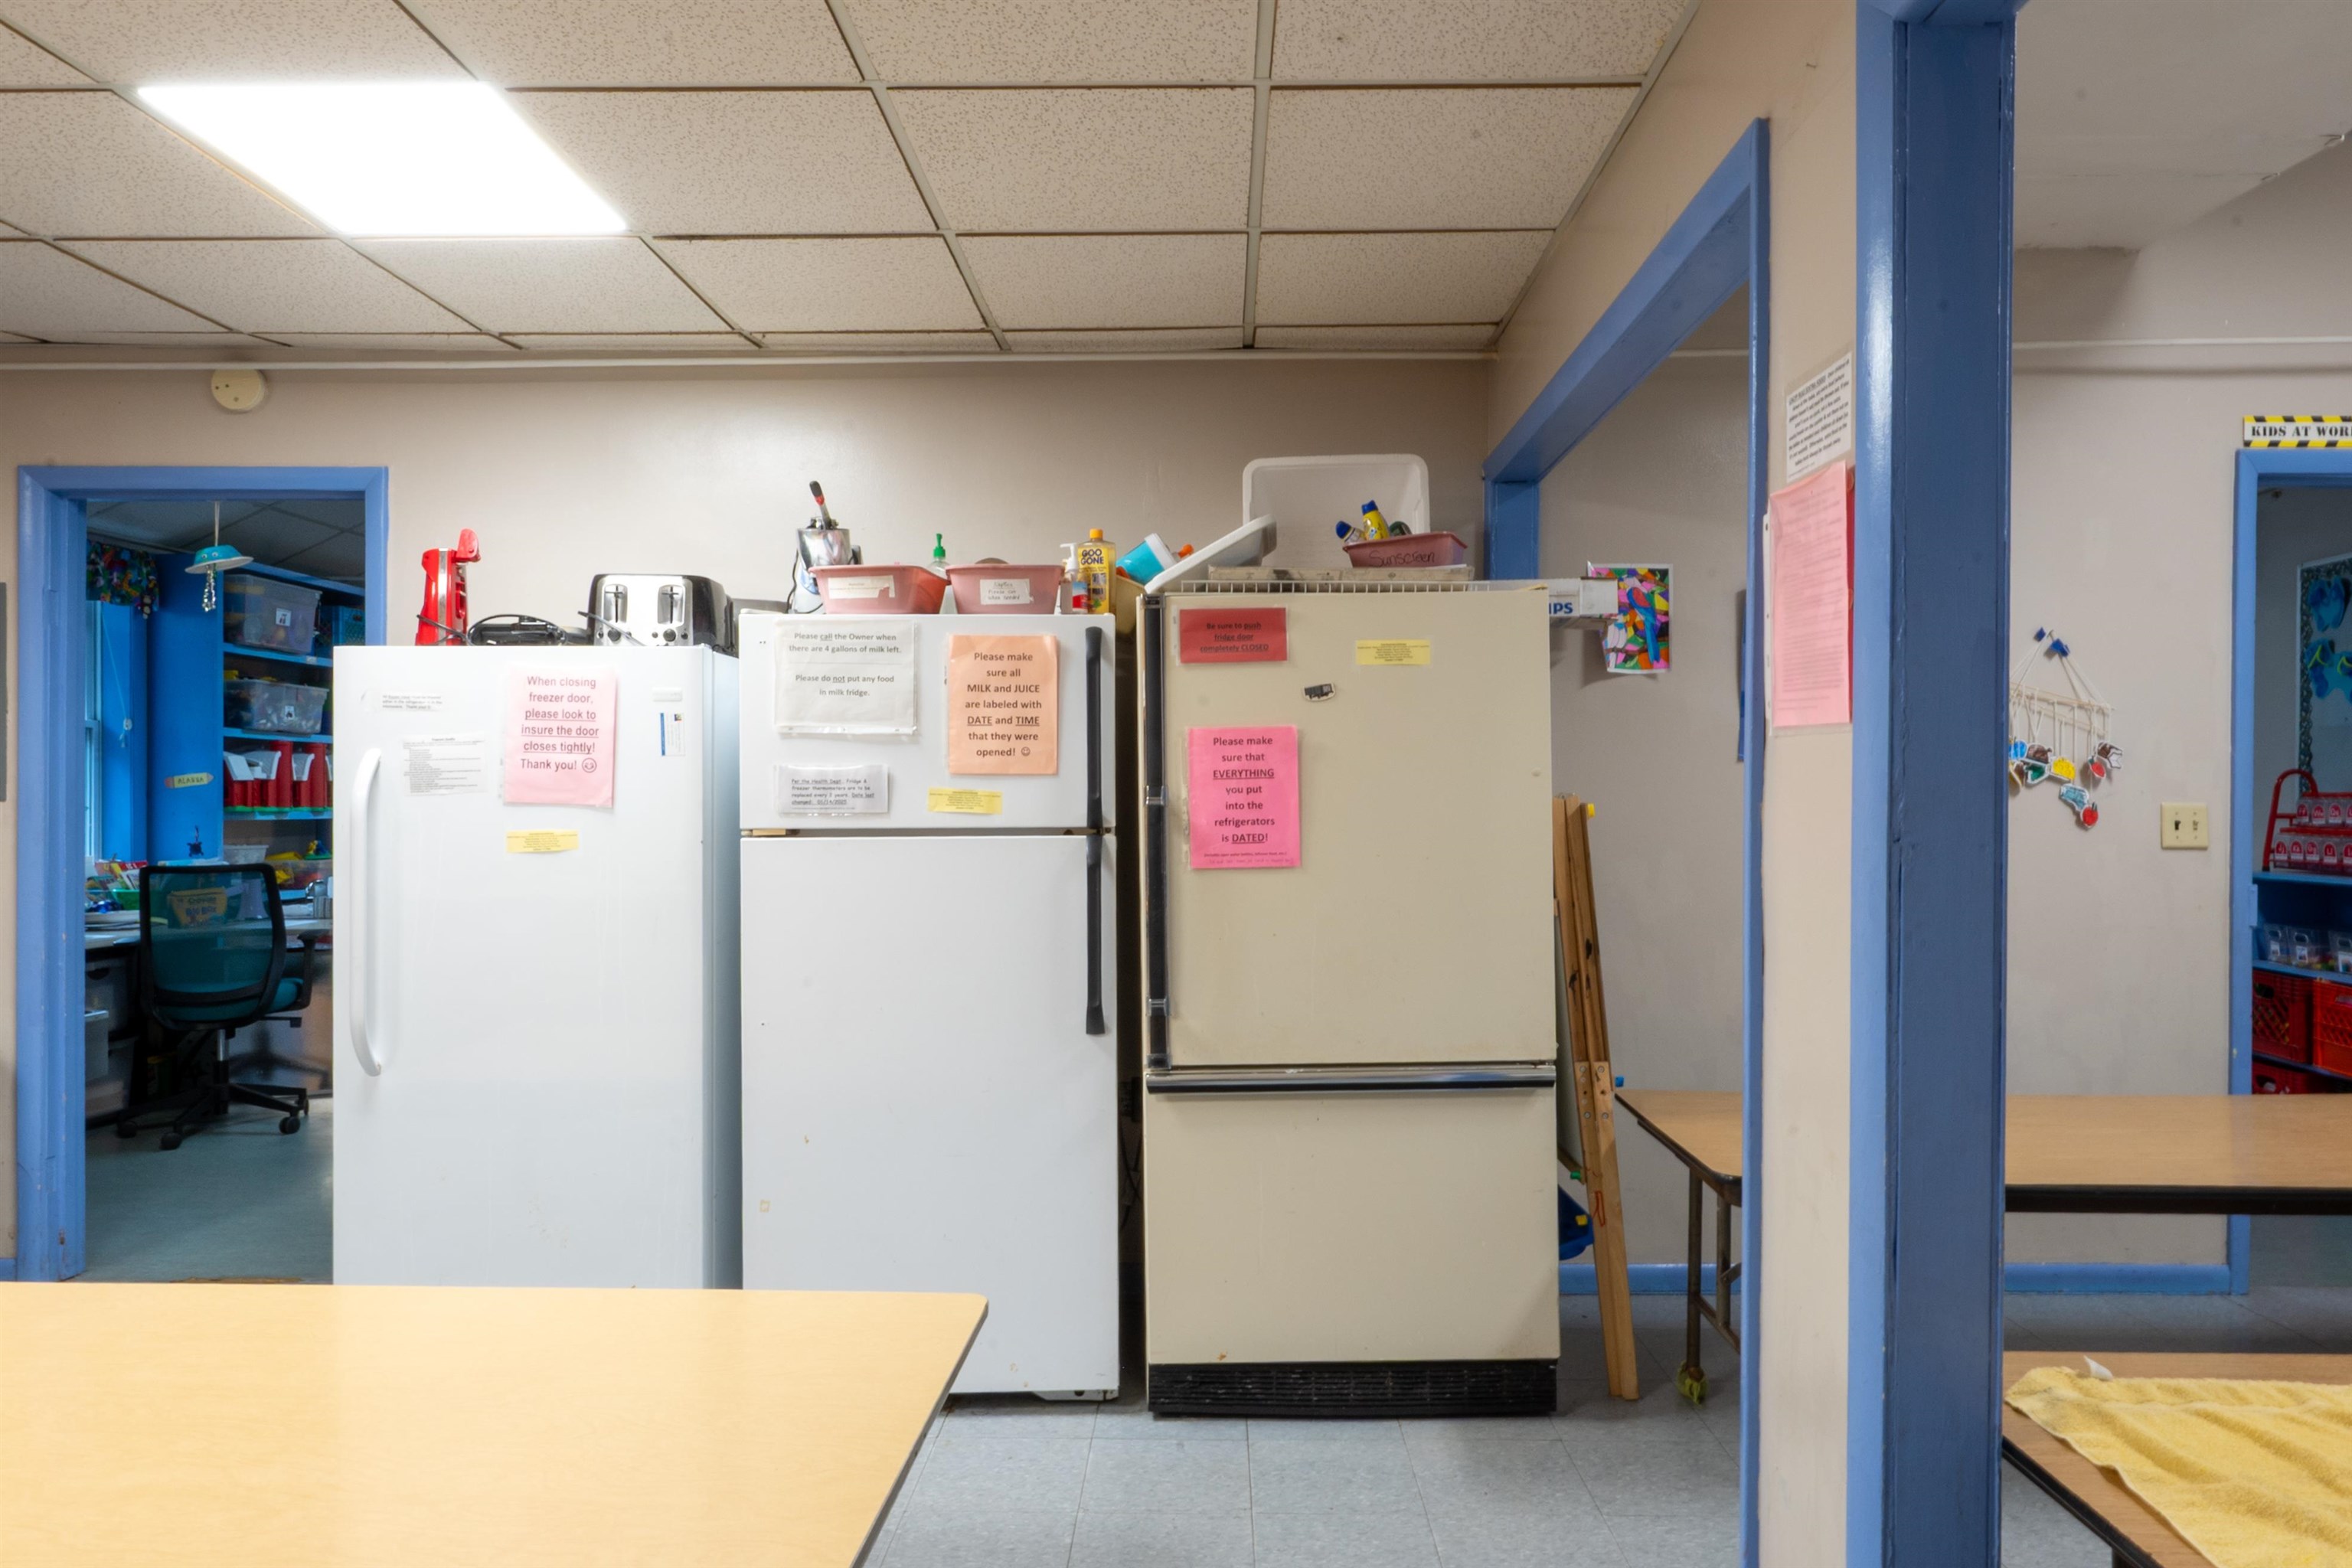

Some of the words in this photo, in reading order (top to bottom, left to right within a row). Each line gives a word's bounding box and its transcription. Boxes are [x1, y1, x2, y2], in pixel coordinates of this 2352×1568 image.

[2252, 426, 2286, 436] KIDS
[2292, 426, 2311, 436] AT
[2316, 426, 2352, 436] WOR
[1082, 548, 1102, 557] GOO
[1080, 557, 1104, 565] GONE
[1369, 550, 1436, 567] Sunscreen
[1244, 622, 1261, 630] push
[1200, 645, 1240, 653] completely
[974, 652, 1004, 661] Please
[1008, 652, 1033, 661] make
[1009, 668, 1021, 677] all
[528, 676, 556, 686] When
[560, 677, 596, 689] closing
[846, 689, 870, 697] fridge.
[994, 684, 1011, 693] and
[1014, 684, 1040, 693] JUICE
[529, 692, 564, 702] freezer
[567, 693, 593, 704] door,
[983, 700, 1018, 708] labeled
[1021, 701, 1041, 709] with
[525, 708, 558, 720] please
[562, 709, 583, 719] look
[586, 710, 596, 720] to
[967, 717, 992, 725] DATE
[1015, 717, 1040, 725] TIME
[521, 724, 553, 734] insure
[557, 725, 572, 735] the
[576, 726, 599, 736] door
[969, 732, 988, 740] that
[991, 732, 1011, 741] they
[1214, 737, 1243, 746] Please
[1246, 737, 1273, 745] make
[524, 741, 557, 751] closes
[560, 742, 595, 755] tightly!
[976, 748, 1015, 757] opened!
[1245, 753, 1265, 761] that
[521, 759, 551, 769] Thank
[555, 760, 577, 772] you!
[1213, 769, 1274, 779] EVERYTHING
[1246, 786, 1263, 795] put
[1225, 802, 1244, 810] into
[1247, 801, 1263, 809] the
[1214, 818, 1275, 828] refrigerators
[1222, 834, 1229, 842] is
[1231, 833, 1268, 843] DATED!
